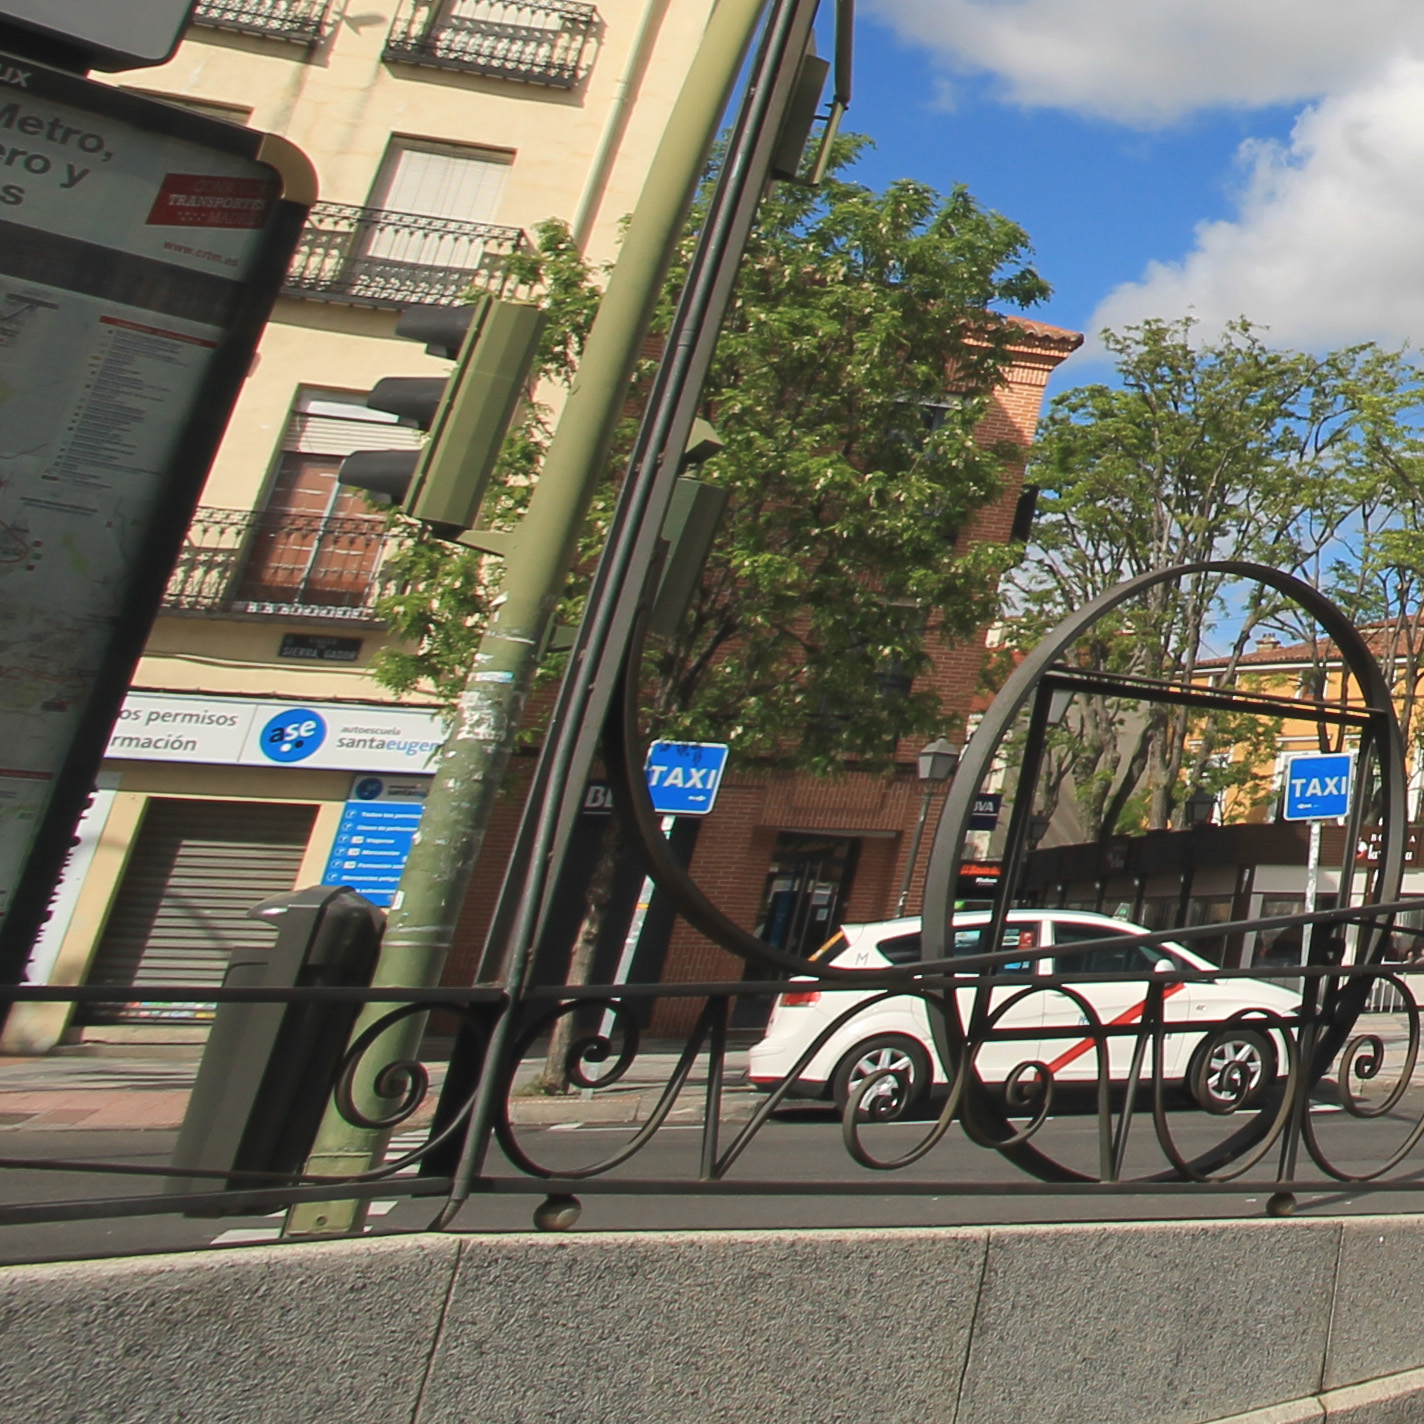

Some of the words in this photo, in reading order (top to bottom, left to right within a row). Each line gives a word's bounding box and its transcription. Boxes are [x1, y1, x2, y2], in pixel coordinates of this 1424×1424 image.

[59, 163, 90, 189] y
[168, 194, 265, 210] TRANSPORTES
[145, 710, 237, 727] permisos
[269, 719, 317, 743] ase
[341, 725, 401, 737] autoescuela
[649, 765, 717, 790] TAXI
[1291, 776, 1347, 798] TAXI
